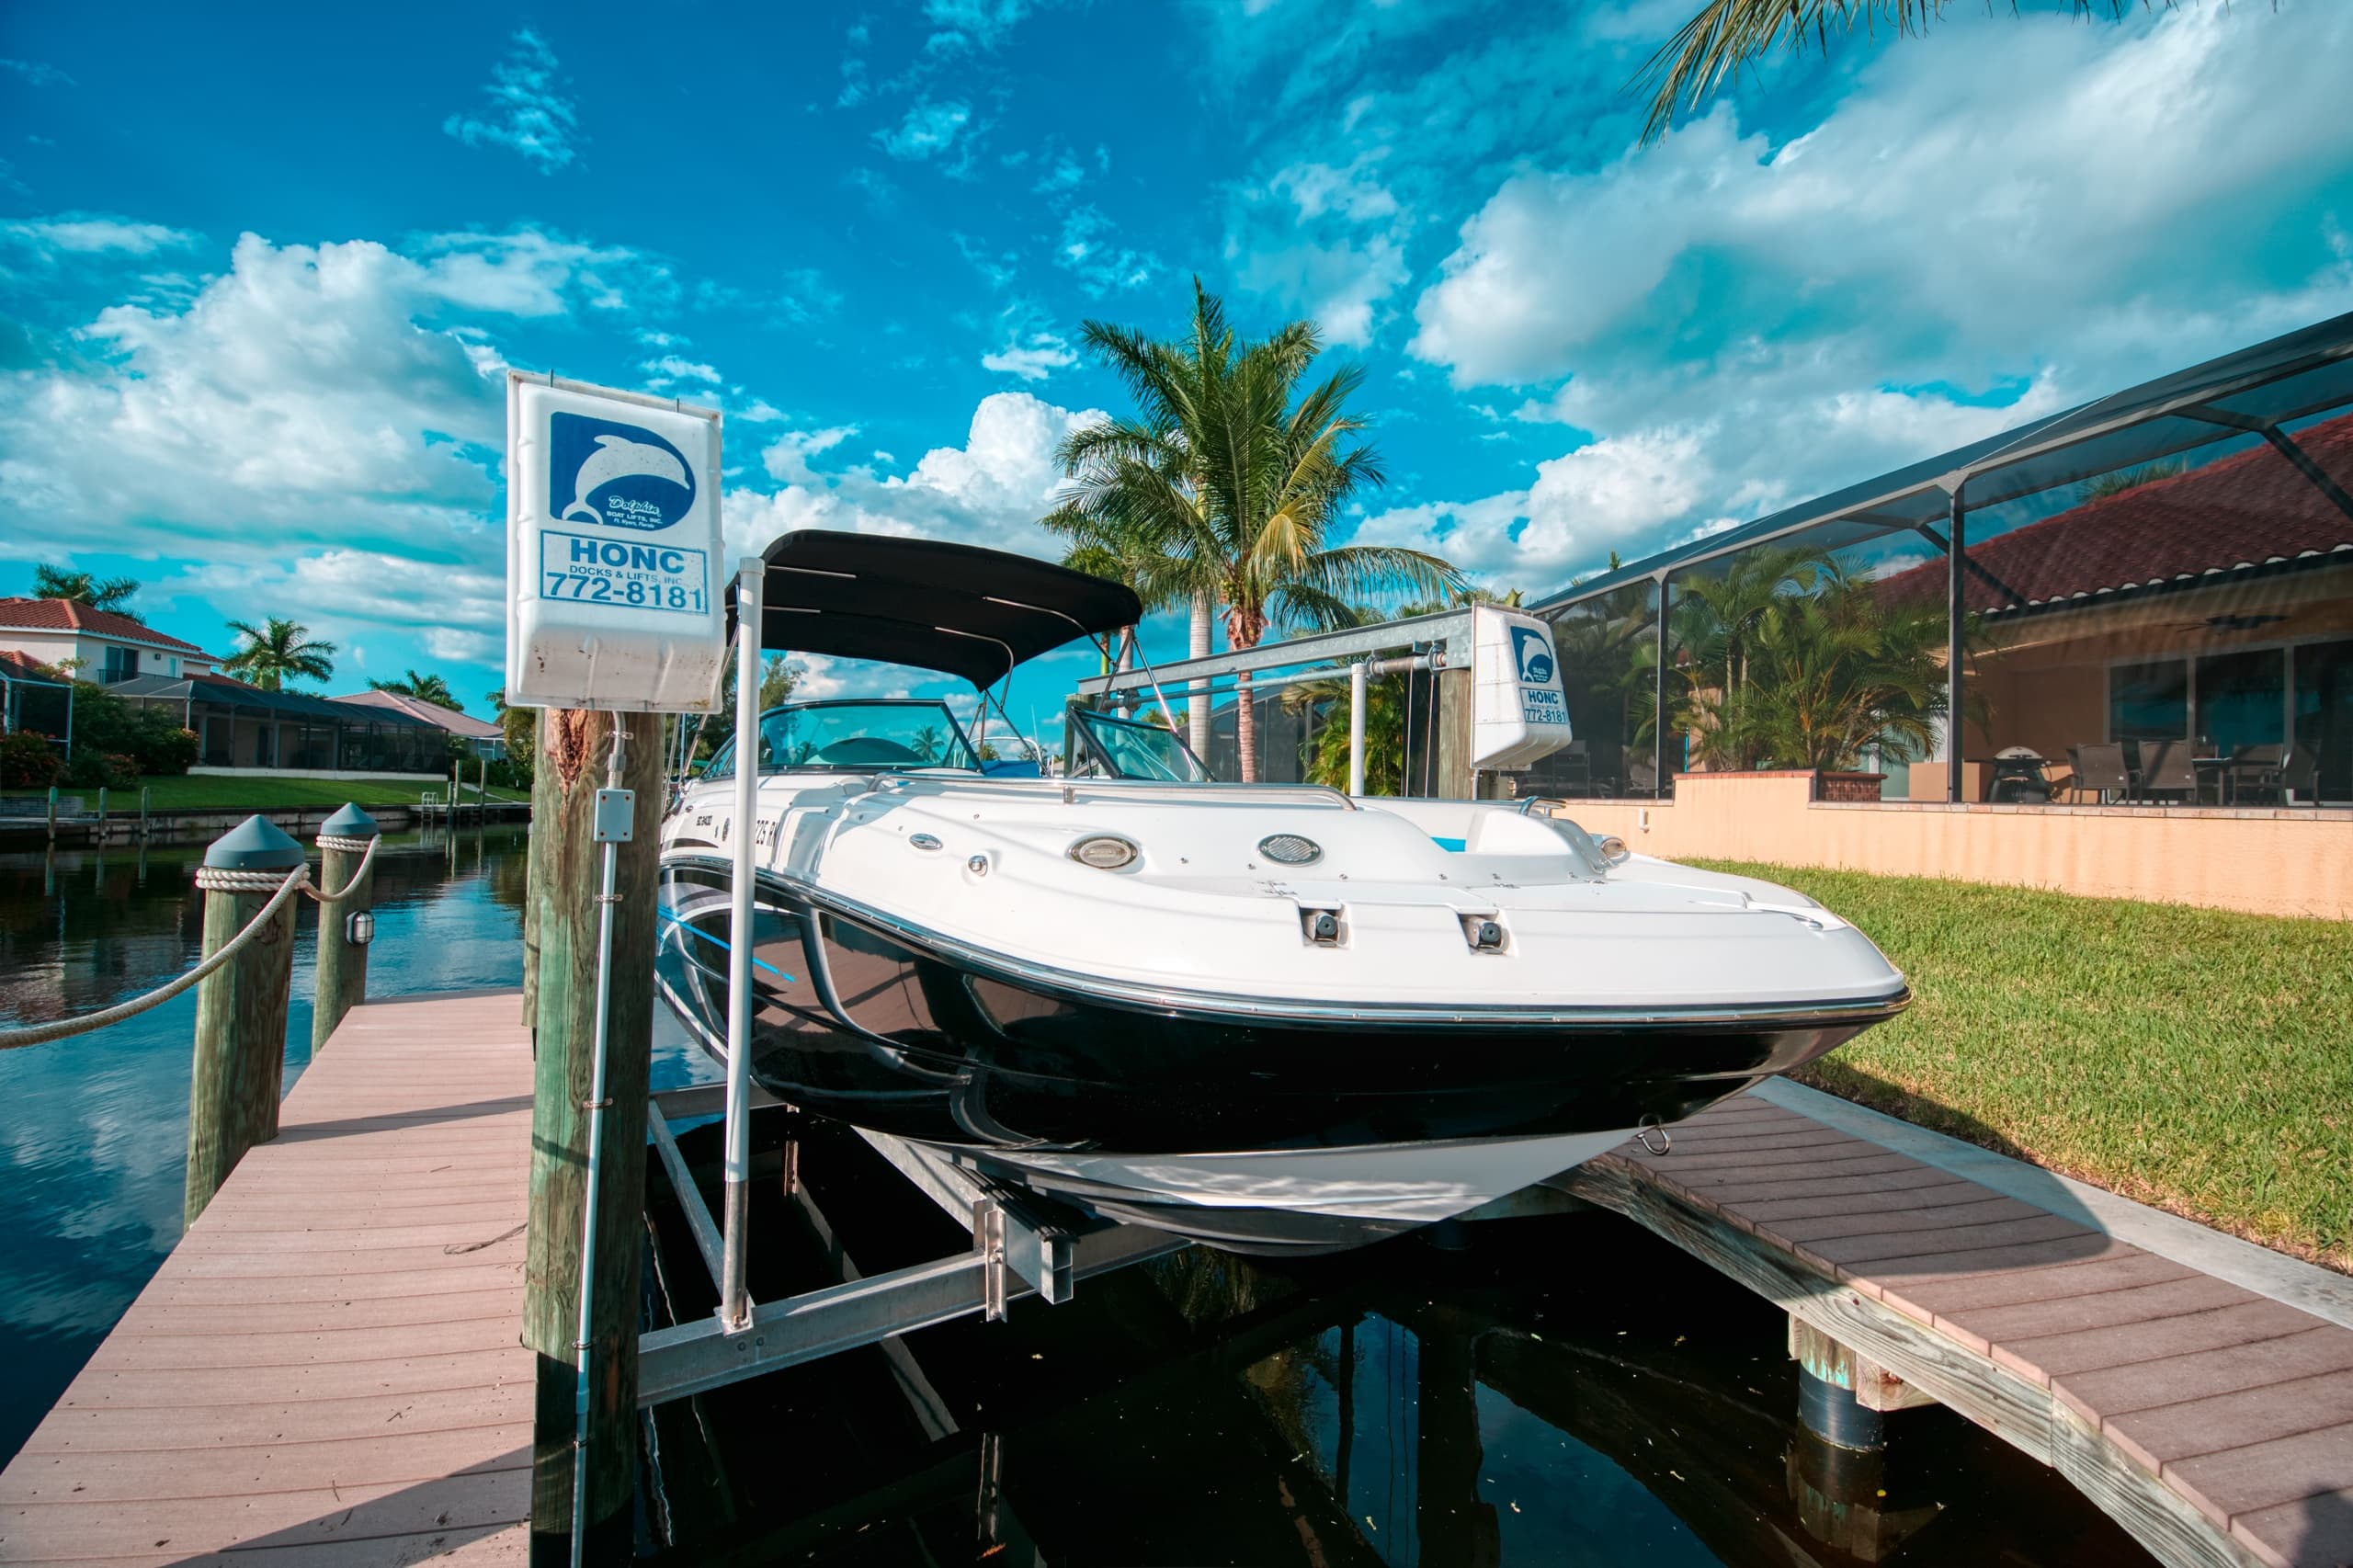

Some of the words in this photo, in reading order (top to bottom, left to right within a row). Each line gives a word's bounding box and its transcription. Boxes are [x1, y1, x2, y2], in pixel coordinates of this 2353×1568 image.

[608, 494, 660, 515] Dolphin
[606, 510, 625, 518] BOAT
[626, 514, 648, 522] LIFTS,
[570, 539, 685, 574] HONC
[569, 565, 612, 578] DOCKS
[616, 571, 623, 579] &
[546, 572, 701, 610] 772-8181
[1528, 690, 1559, 705] HONC
[1525, 709, 1567, 722] 772-8181
